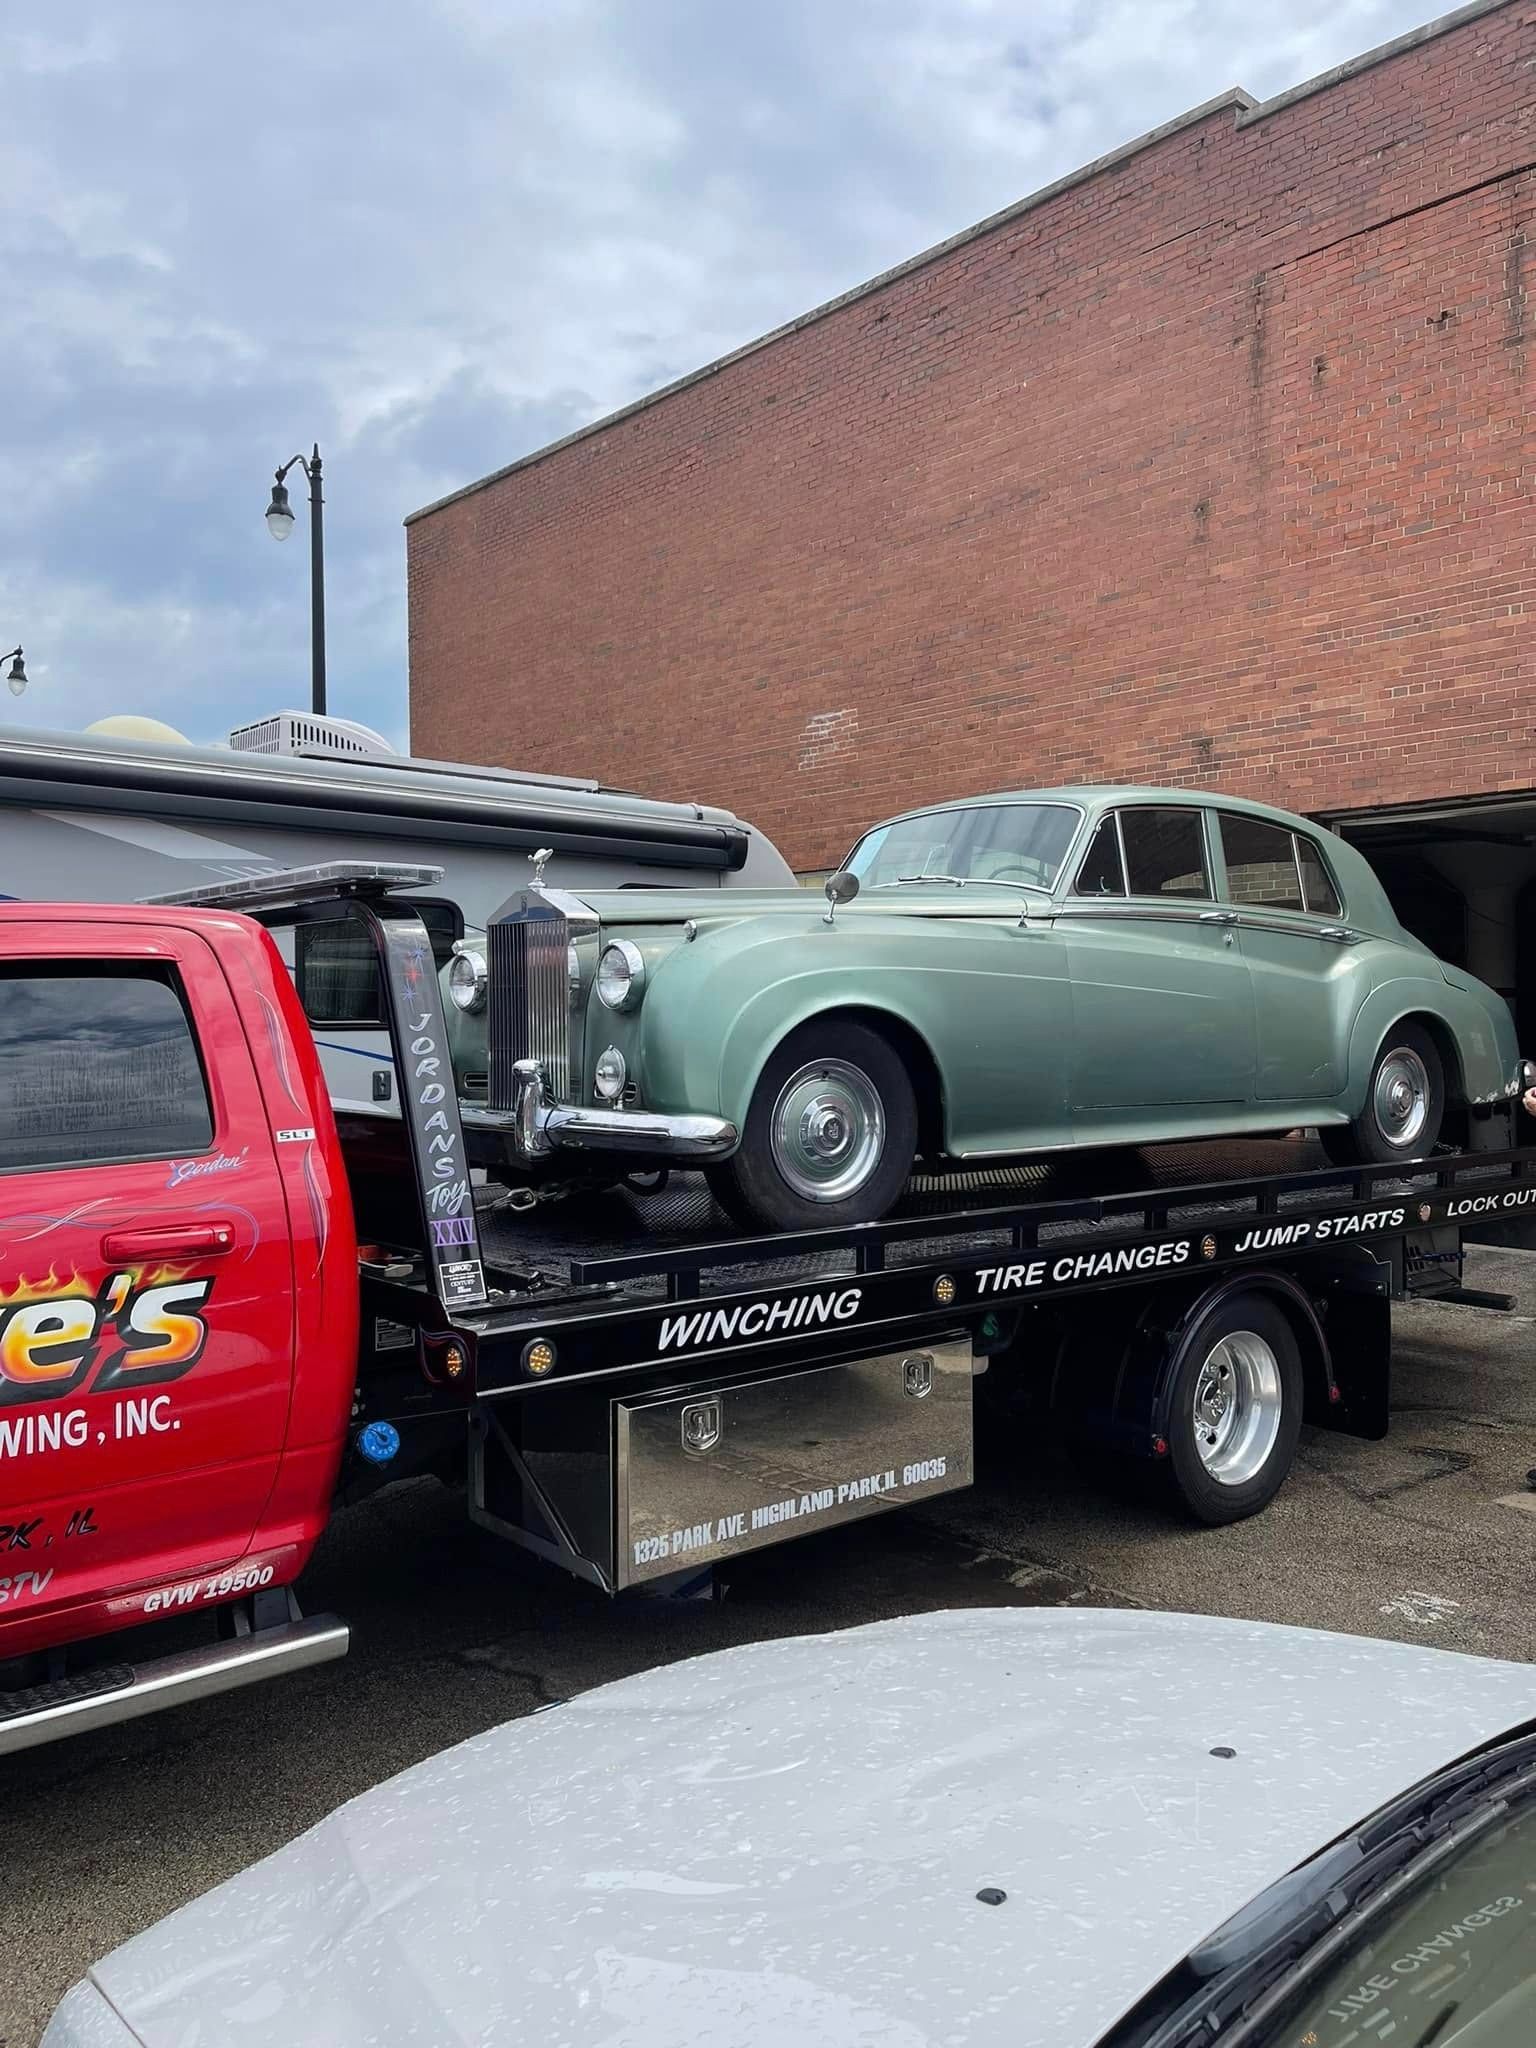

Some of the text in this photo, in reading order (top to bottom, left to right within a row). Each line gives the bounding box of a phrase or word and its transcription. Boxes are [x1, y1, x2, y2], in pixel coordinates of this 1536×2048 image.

[280, 1129, 311, 1140] SLT
[425, 1179, 472, 1216] Toy
[1446, 1194, 1499, 1216] LOCK
[430, 1217, 477, 1247] XXIV
[1235, 1208, 1406, 1253] JUMP STARTS
[976, 1241, 1190, 1294] TIRE CHANGES
[658, 1288, 863, 1351] WINCHING
[115, 1395, 181, 1439] INC.
[64, 1507, 98, 1537] IL
[633, 1536, 670, 1565] 1325
[672, 1522, 713, 1553] PARK
[717, 1513, 749, 1541] AVE.
[751, 1489, 834, 1530] HIGHLAND
[903, 1456, 947, 1486] 60035
[143, 1565, 275, 1613] GVW 19500
